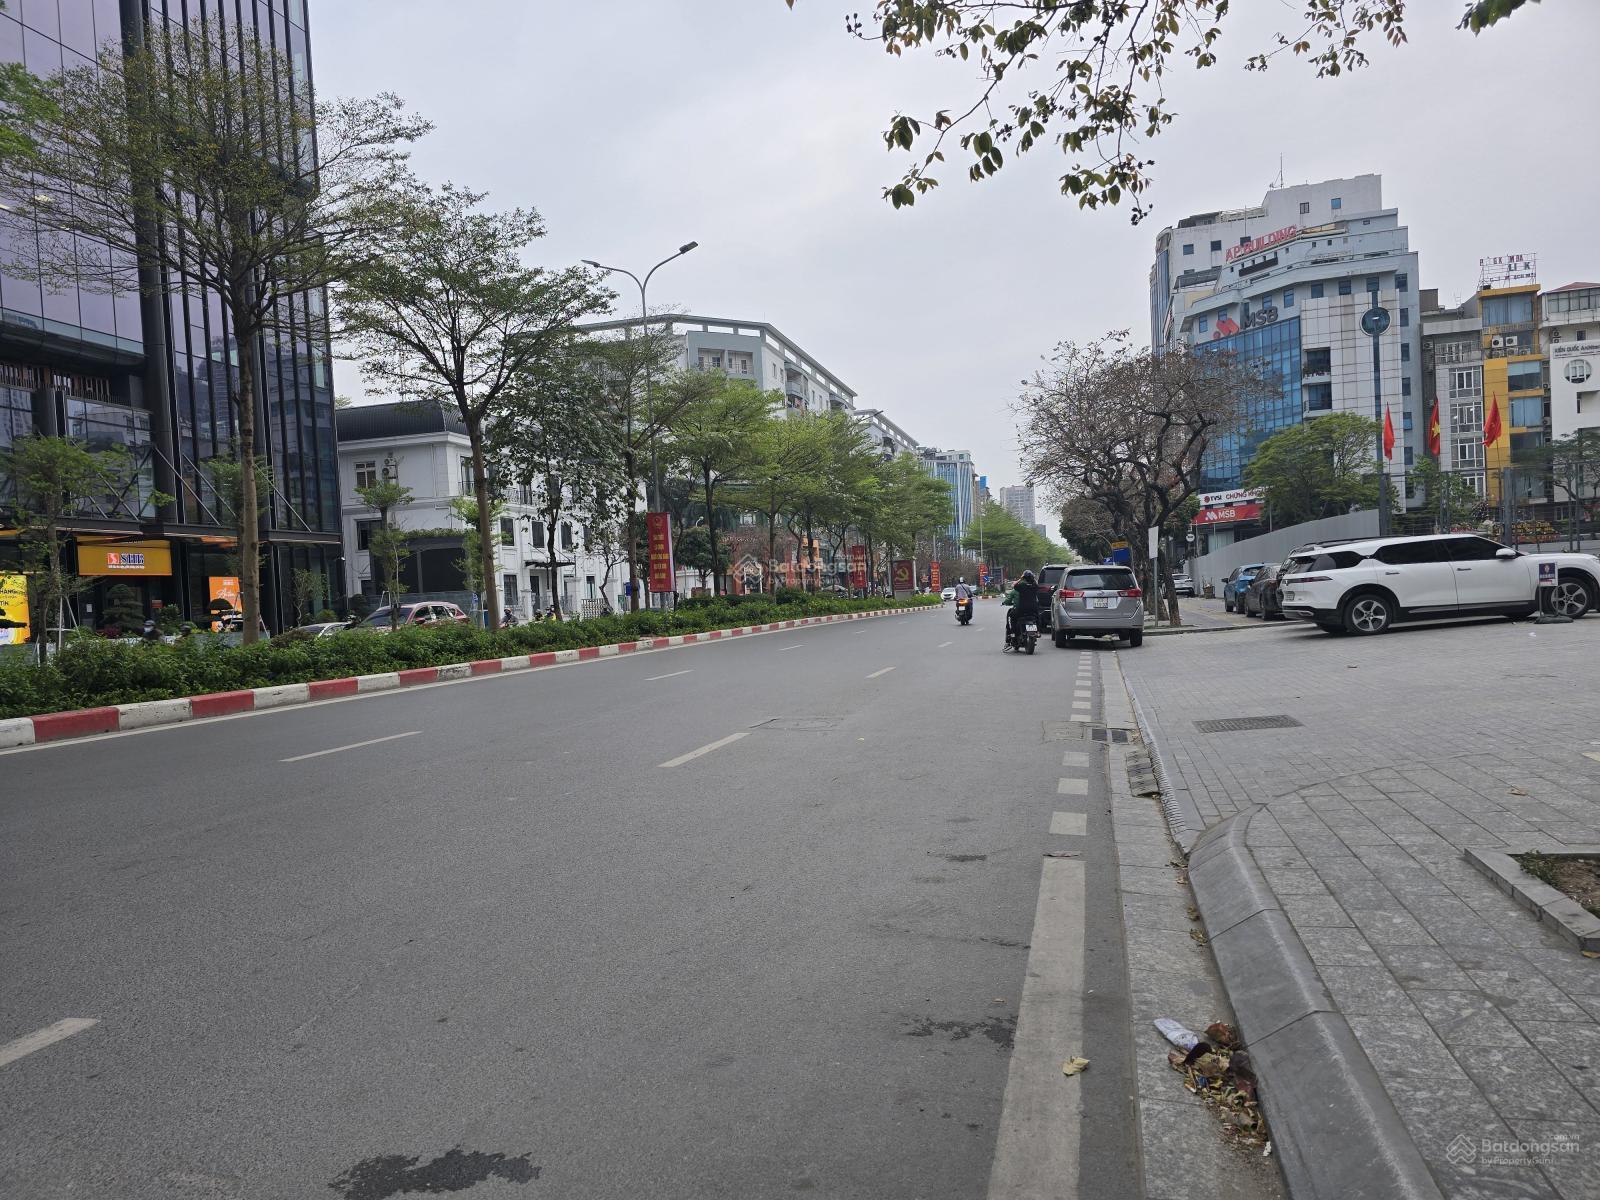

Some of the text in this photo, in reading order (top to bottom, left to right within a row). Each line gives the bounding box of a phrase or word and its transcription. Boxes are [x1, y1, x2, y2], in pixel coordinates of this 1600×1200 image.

[1244, 225, 1297, 254] BUILDING
[1241, 306, 1279, 329] MSB
[1219, 510, 1236, 519] MSB
